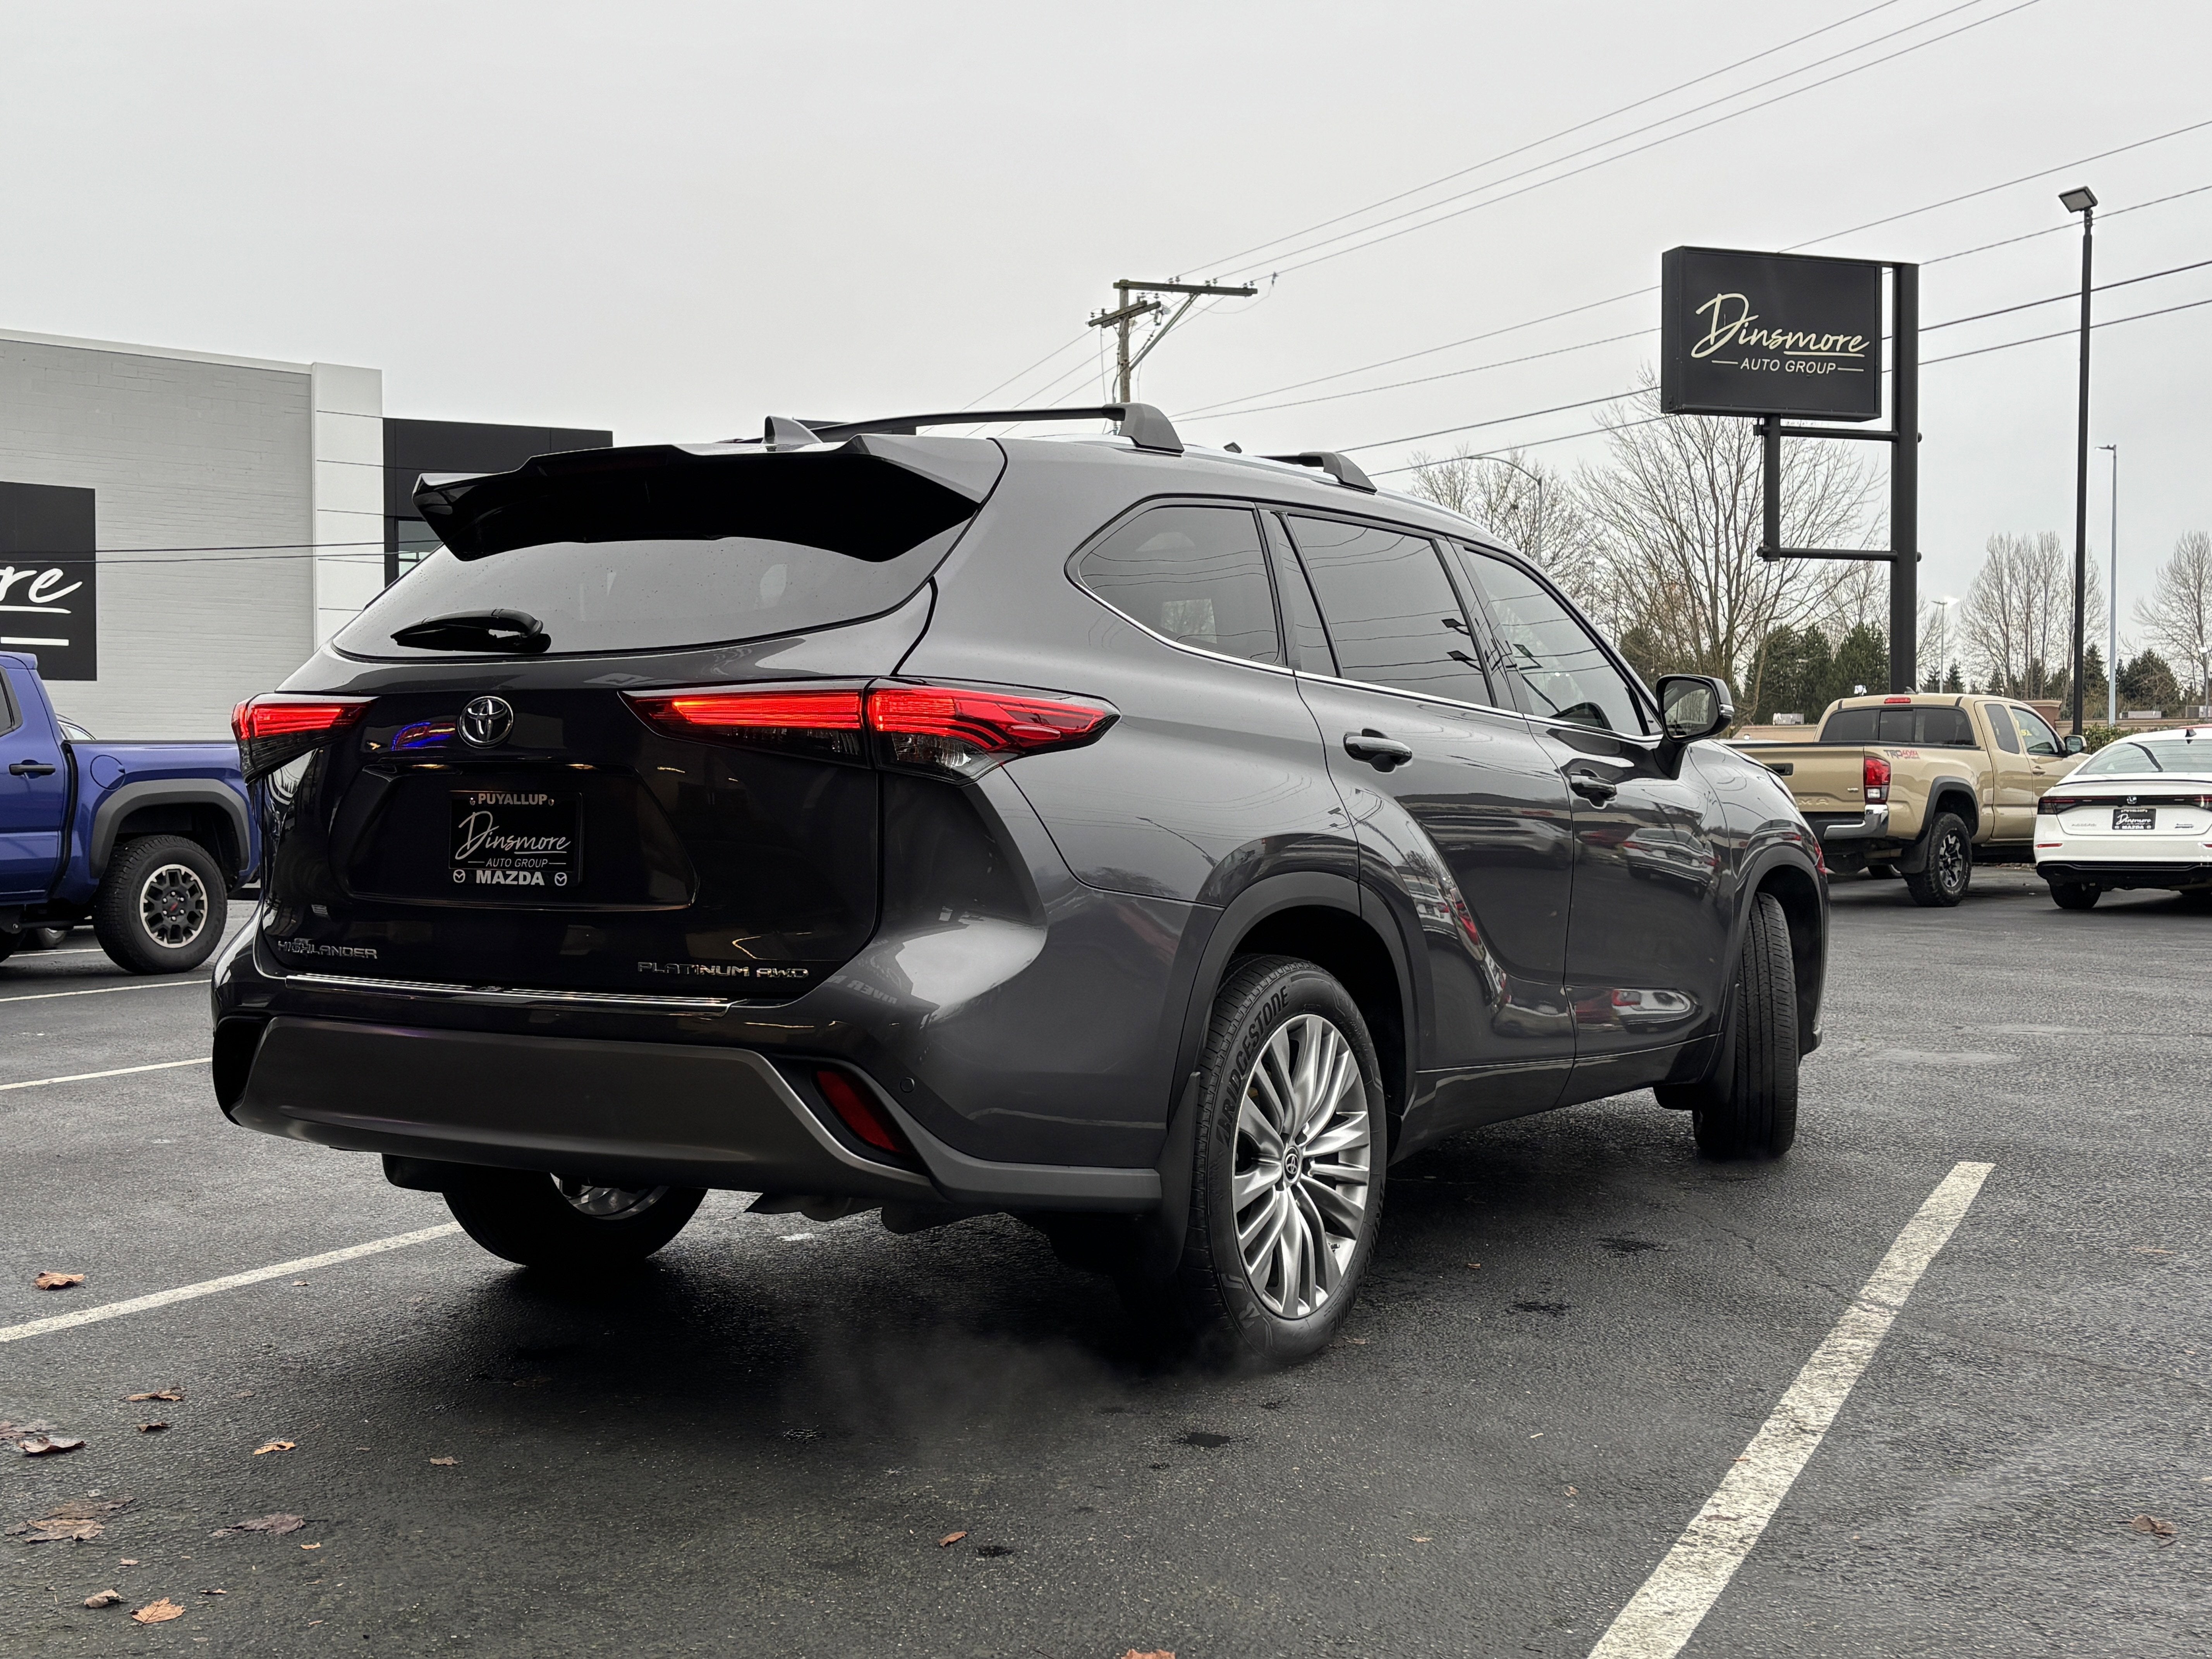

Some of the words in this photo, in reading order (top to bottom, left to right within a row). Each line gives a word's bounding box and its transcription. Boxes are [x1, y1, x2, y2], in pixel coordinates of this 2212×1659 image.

[1691, 293, 1870, 358] Dinsmore
[1740, 357, 1780, 372] AUTO
[1785, 360, 1836, 374] GROUP
[478, 793, 548, 805] PUYALLUP
[455, 811, 571, 860] Dinsmore
[486, 858, 512, 867] AUTO
[514, 859, 548, 868] GROUP
[476, 870, 545, 886] MAZDA
[278, 940, 378, 959] HIGHLANDER
[637, 962, 750, 977] PLATINUM
[756, 967, 809, 979] AWD
